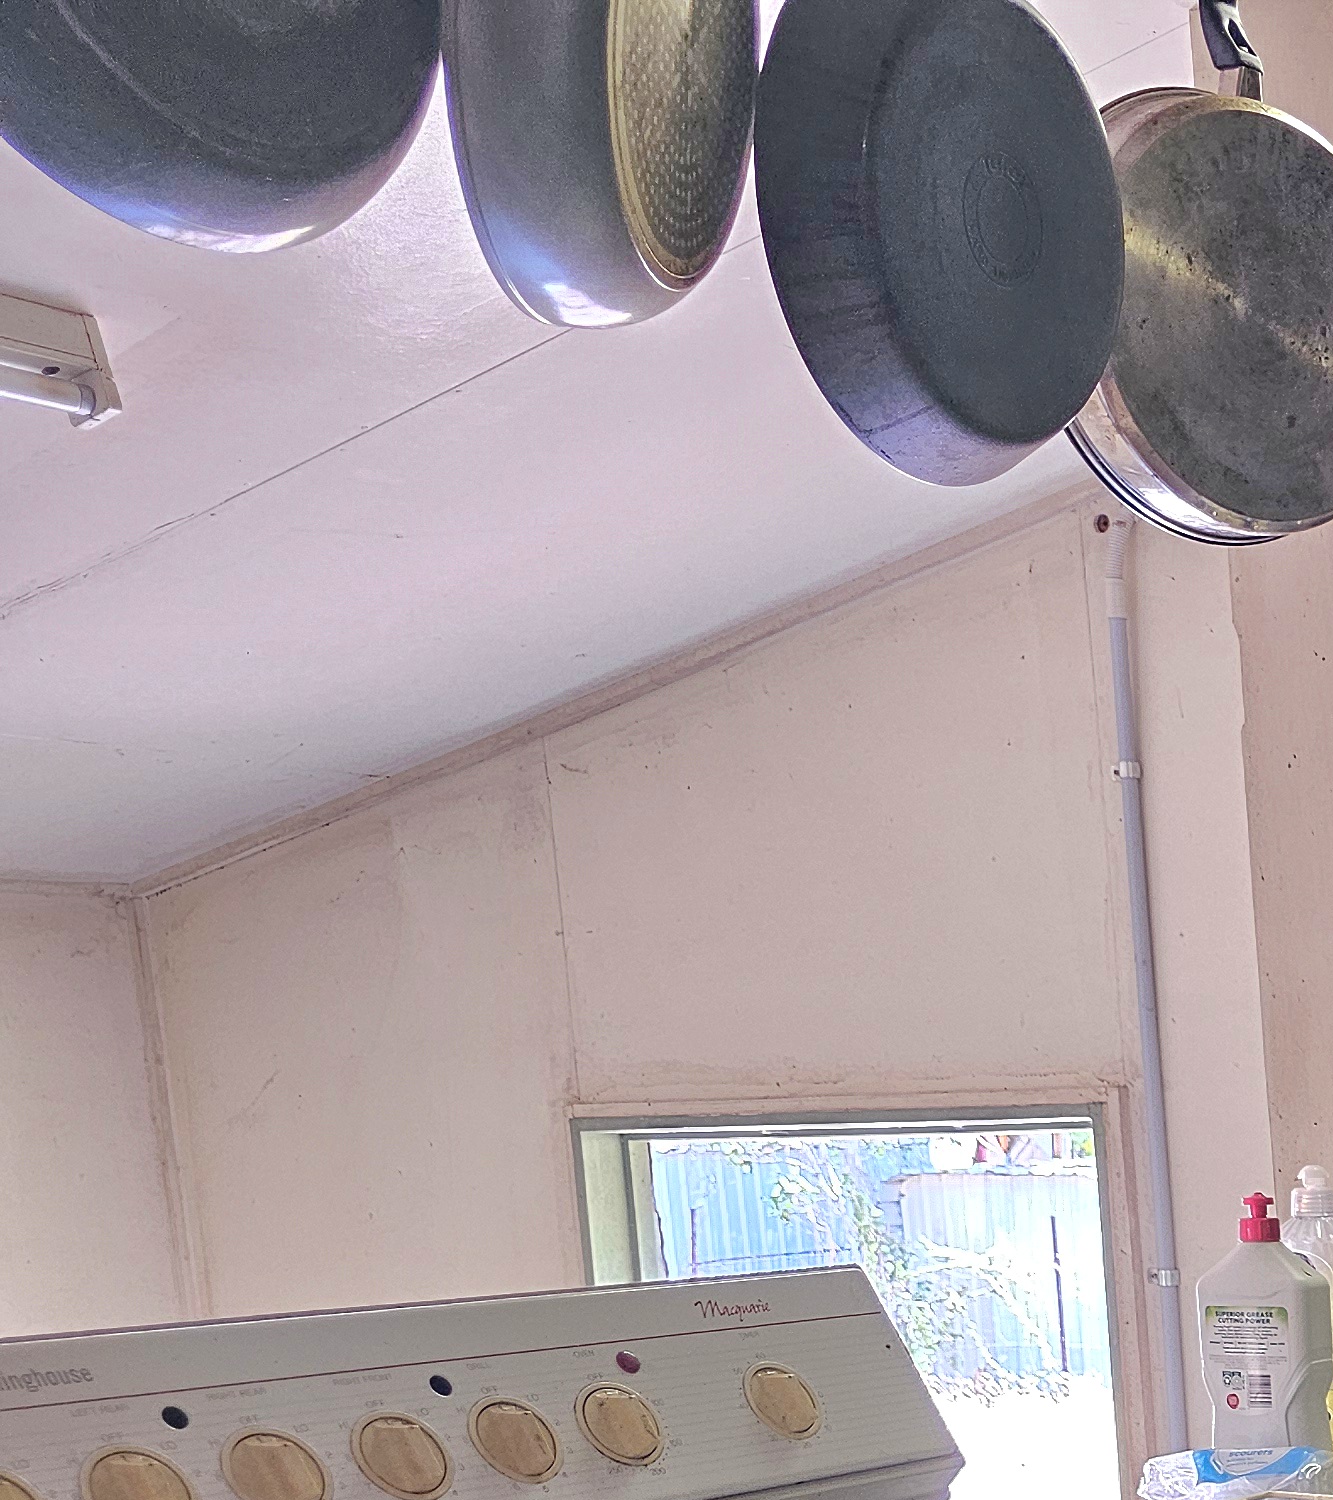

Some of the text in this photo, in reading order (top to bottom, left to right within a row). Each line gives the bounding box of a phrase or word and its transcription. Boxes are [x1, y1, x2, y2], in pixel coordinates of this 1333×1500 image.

[694, 1299, 771, 1322] Macquarie
[1215, 1310, 1244, 1318] SUPERIOR
[1229, 1449, 1273, 1457] scourers
